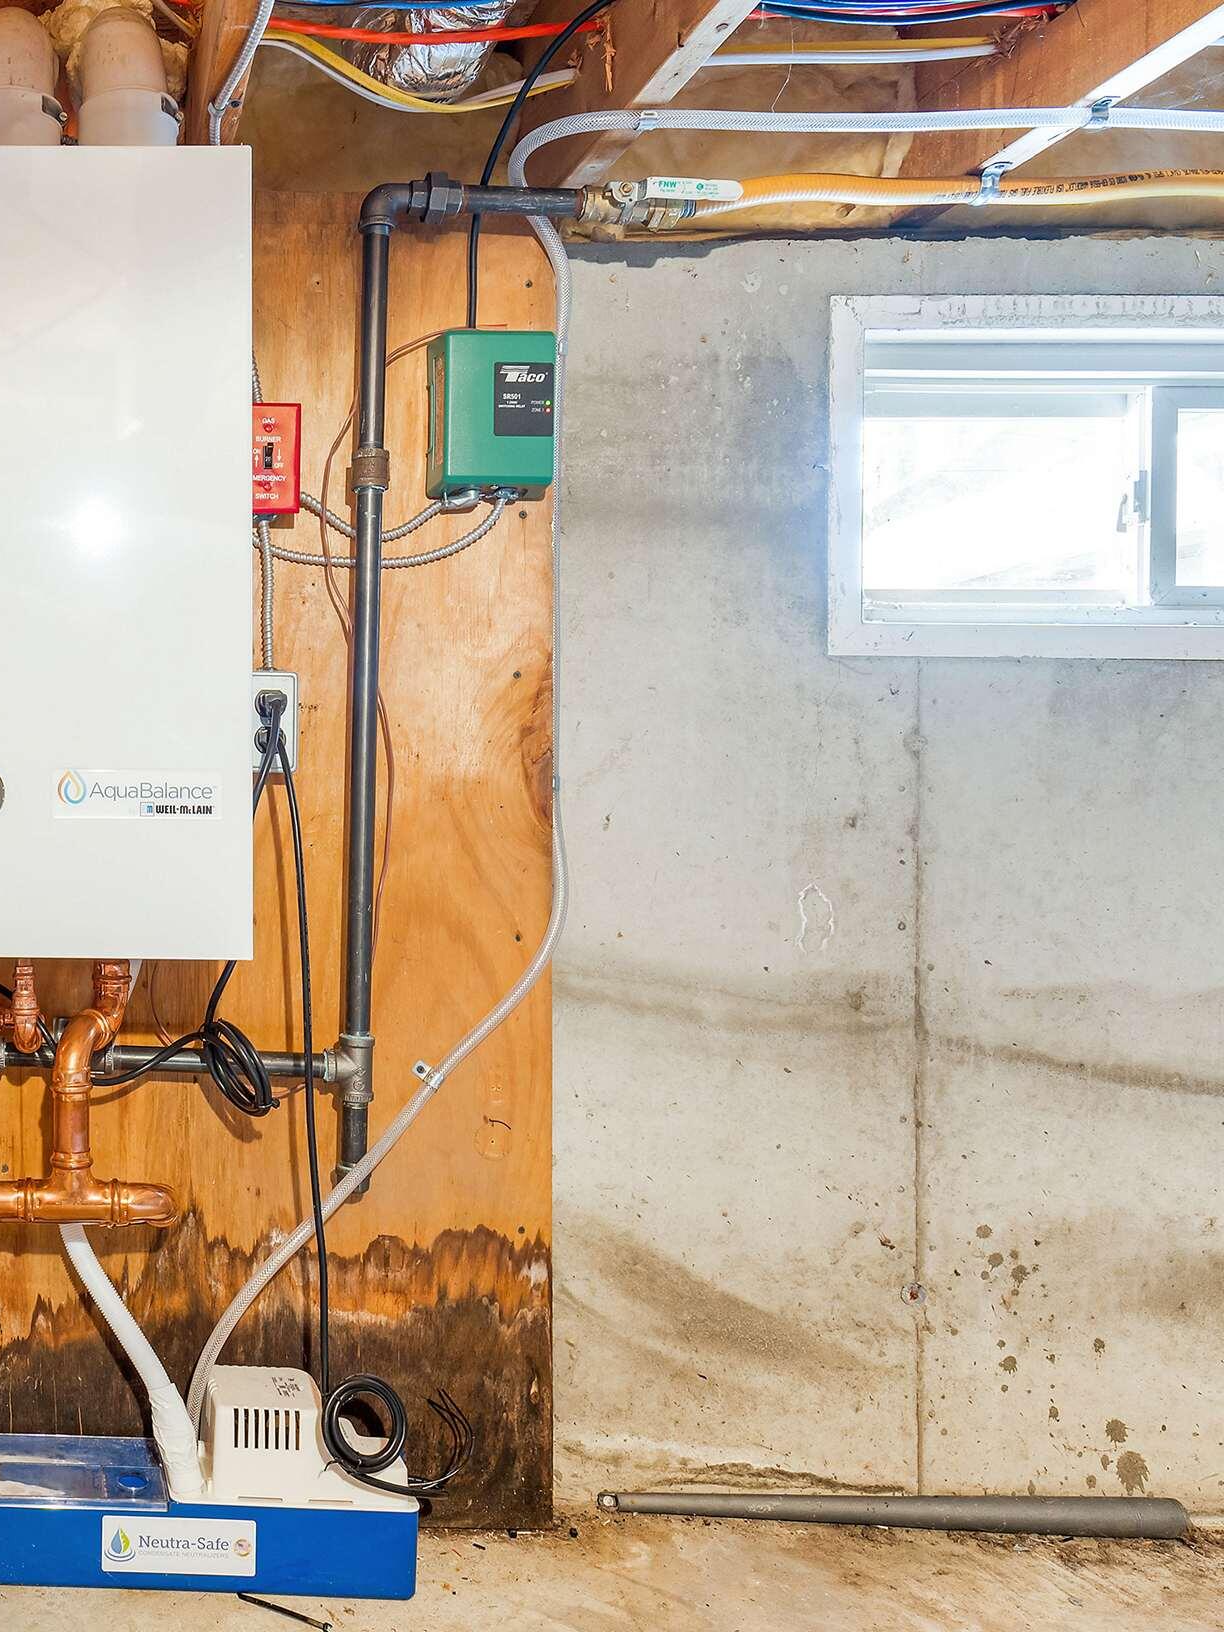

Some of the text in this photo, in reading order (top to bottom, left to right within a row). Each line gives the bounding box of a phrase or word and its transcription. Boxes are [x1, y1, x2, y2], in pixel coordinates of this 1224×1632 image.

[499, 365, 546, 382] Taco
[89, 782, 213, 801] AquaBalance
[137, 1535, 230, 1551] Neutra-Safe
